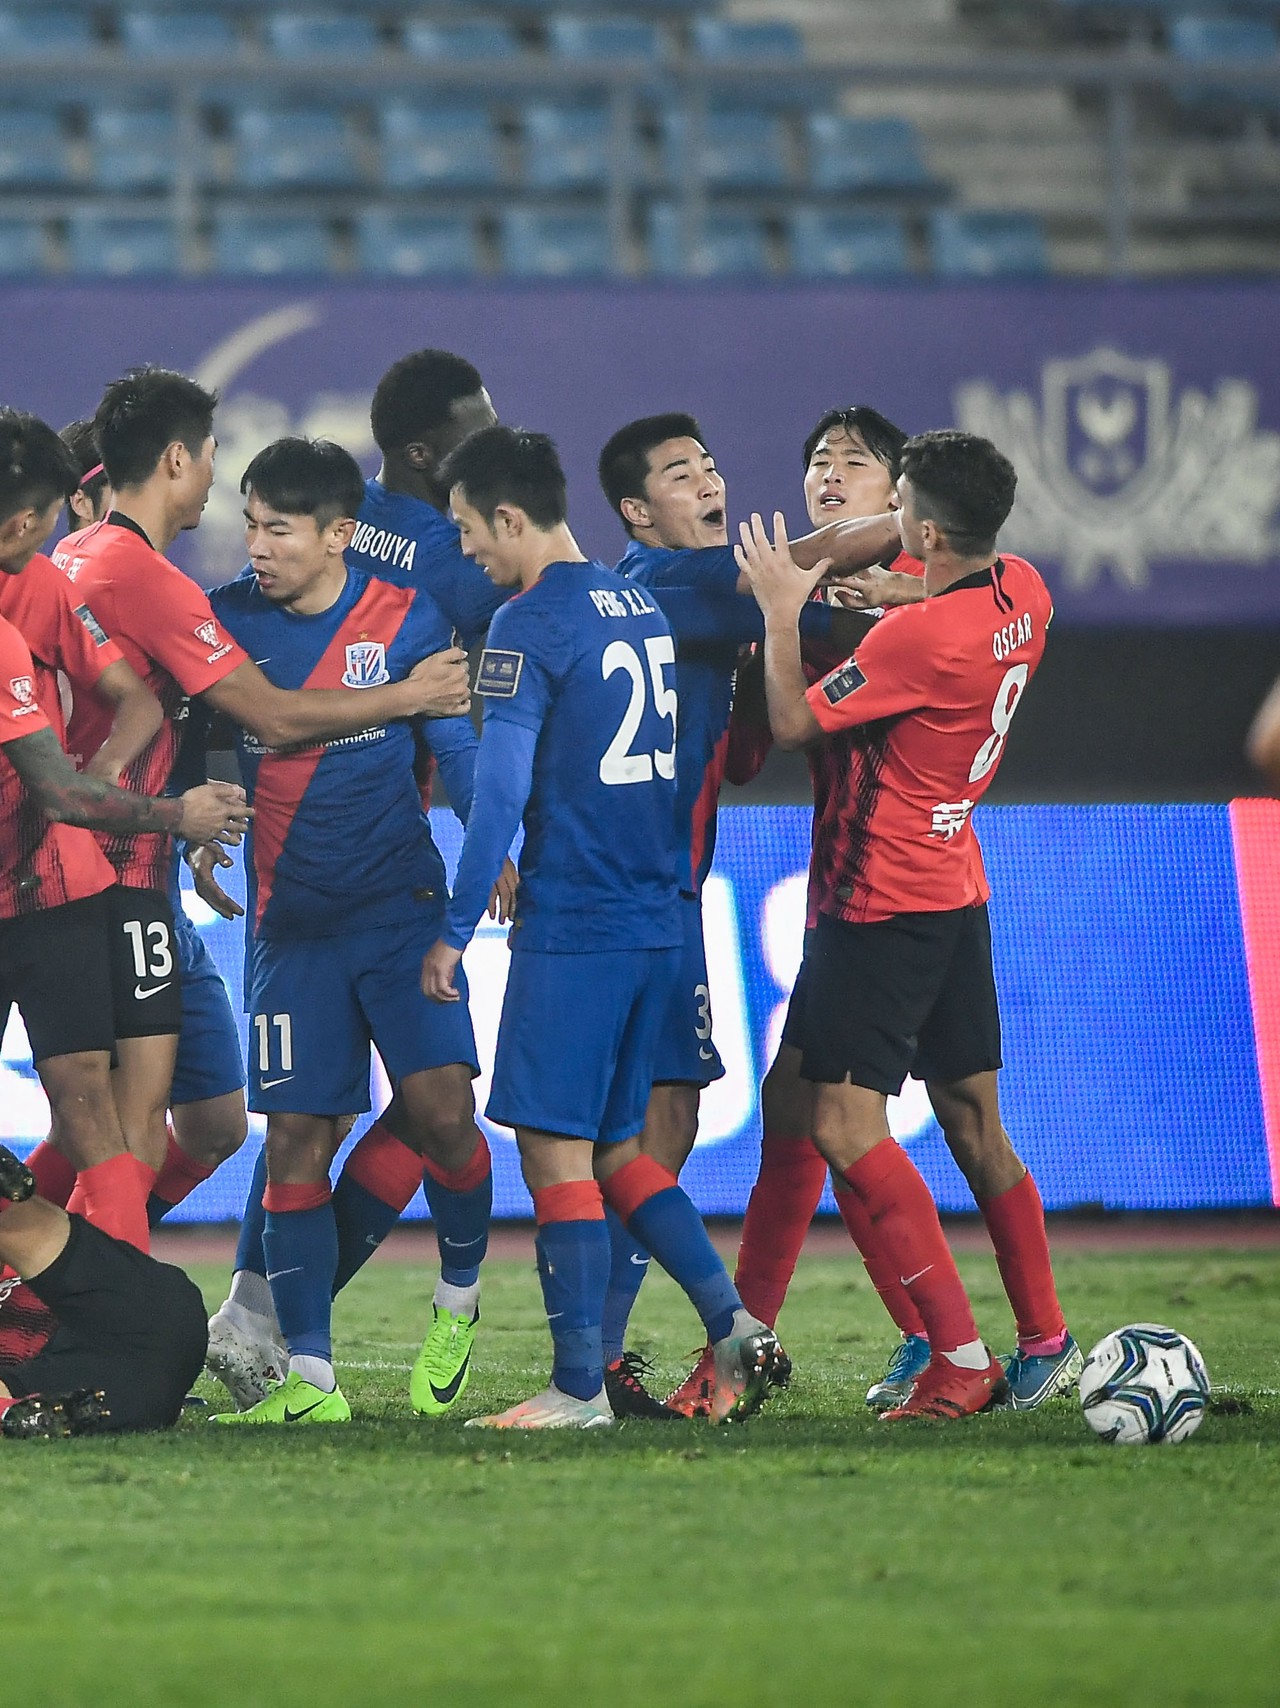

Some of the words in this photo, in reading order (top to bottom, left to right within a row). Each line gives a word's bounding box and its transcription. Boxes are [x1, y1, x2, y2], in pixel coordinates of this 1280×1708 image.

[589, 589, 628, 618] PENG
[992, 612, 1033, 661] OSCAR
[599, 635, 678, 785] 25
[969, 663, 1029, 783] 8
[123, 919, 173, 978] 13
[254, 1012, 293, 1072] 11
[693, 984, 713, 1041] 3
